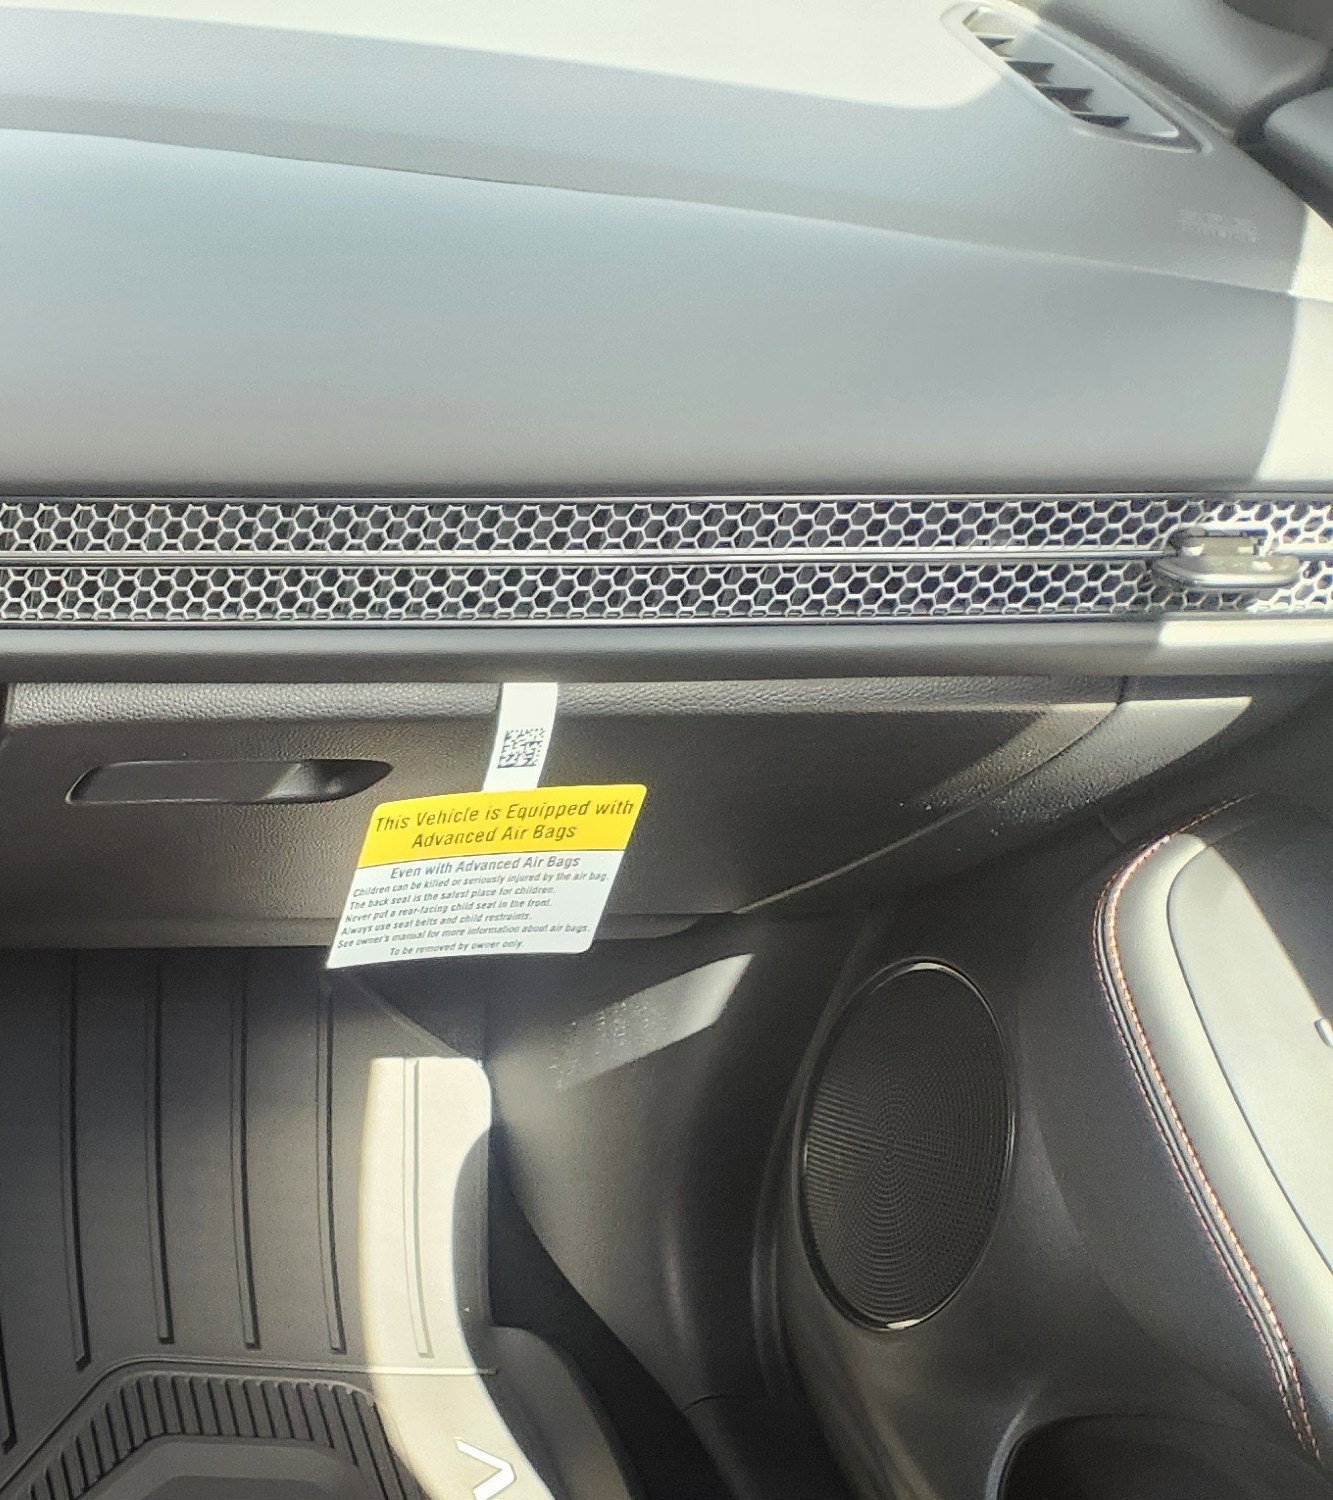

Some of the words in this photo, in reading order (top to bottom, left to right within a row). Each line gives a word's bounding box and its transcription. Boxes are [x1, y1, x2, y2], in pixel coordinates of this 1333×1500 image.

[375, 815, 410, 832] This
[416, 807, 479, 826] Vehicle
[485, 805, 501, 820] is
[506, 800, 591, 820] Equipped
[595, 800, 634, 815] with
[411, 827, 498, 849] Advanced
[501, 825, 529, 841] Air
[533, 824, 577, 841] Bags
[390, 867, 421, 879] Even
[424, 862, 453, 876] with
[455, 857, 520, 874] Advanced
[523, 856, 545, 868] Air
[546, 855, 581, 869] Bags
[353, 885, 390, 898] Children
[392, 883, 408, 892] can
[410, 881, 422, 890] be
[423, 878, 451, 889] killed
[451, 878, 462, 886] or
[463, 874, 505, 886] seriously
[507, 872, 541, 883] injured
[542, 872, 554, 882] by
[556, 872, 572, 881] the
[573, 872, 587, 880] air
[350, 901, 366, 910] The
[368, 897, 389, 907] back
[390, 895, 412, 905] seat
[412, 893, 421, 902] is
[423, 892, 438, 901] the
[440, 889, 470, 900] safest
[470, 887, 497, 899] place
[499, 887, 512, 896] for
[345, 913, 372, 923] Never
[373, 910, 389, 921] put
[398, 903, 448, 917] rear-facing
[450, 901, 475, 912] child
[476, 900, 497, 910] seat
[498, 899, 508, 908] in
[510, 899, 525, 908] the
[337, 940, 354, 948] See
[391, 930, 426, 941] manual
[427, 929, 440, 938] for
[441, 928, 466, 937] more
[467, 925, 520, 936] information
[521, 924, 549, 933] about
[549, 924, 564, 932] air
[341, 925, 373, 936] Always
[375, 923, 391, 931] use
[393, 919, 414, 929] seat
[415, 916, 438, 927] belts
[439, 915, 458, 925] and
[459, 914, 484, 923] child
[390, 946, 401, 956] To
[401, 945, 413, 955] be
[415, 942, 456, 954] removed
[457, 942, 469, 952] by
[471, 940, 501, 950] owner
